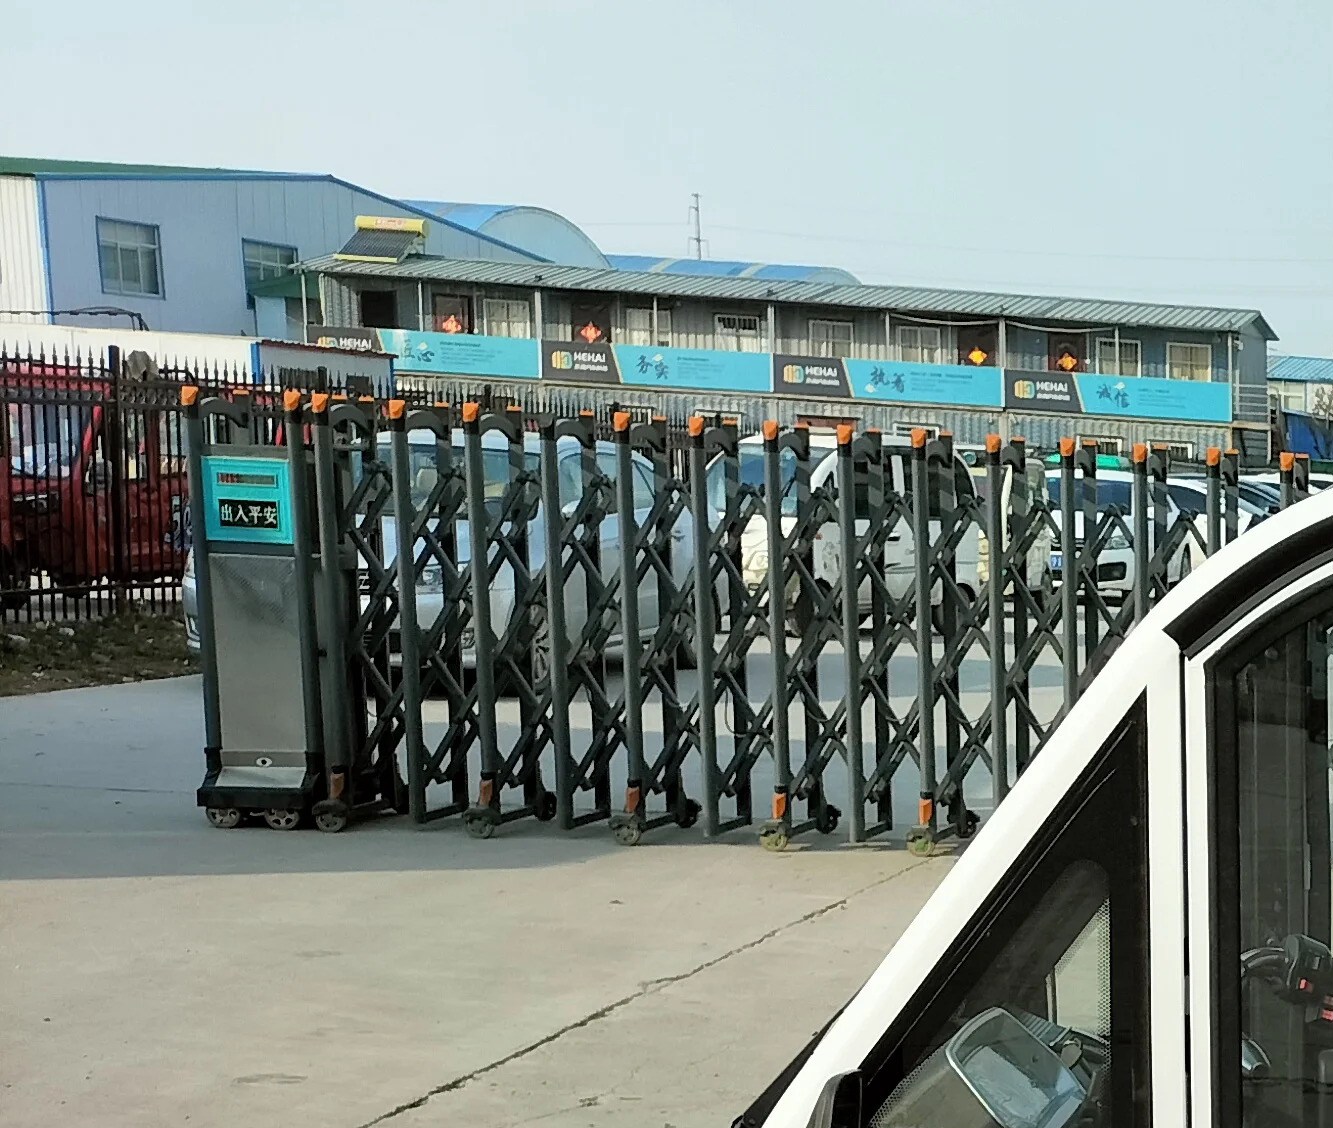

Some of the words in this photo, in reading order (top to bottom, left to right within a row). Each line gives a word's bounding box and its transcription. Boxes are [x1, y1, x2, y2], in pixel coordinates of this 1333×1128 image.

[338, 337, 372, 350] HEHAI
[573, 351, 606, 363] HEHAI
[636, 354, 669, 380] 务实
[804, 365, 838, 377] HEHAI
[1036, 381, 1068, 393] HEHAI
[1096, 382, 1130, 409] 诚信
[221, 503, 277, 525] 出入平安
